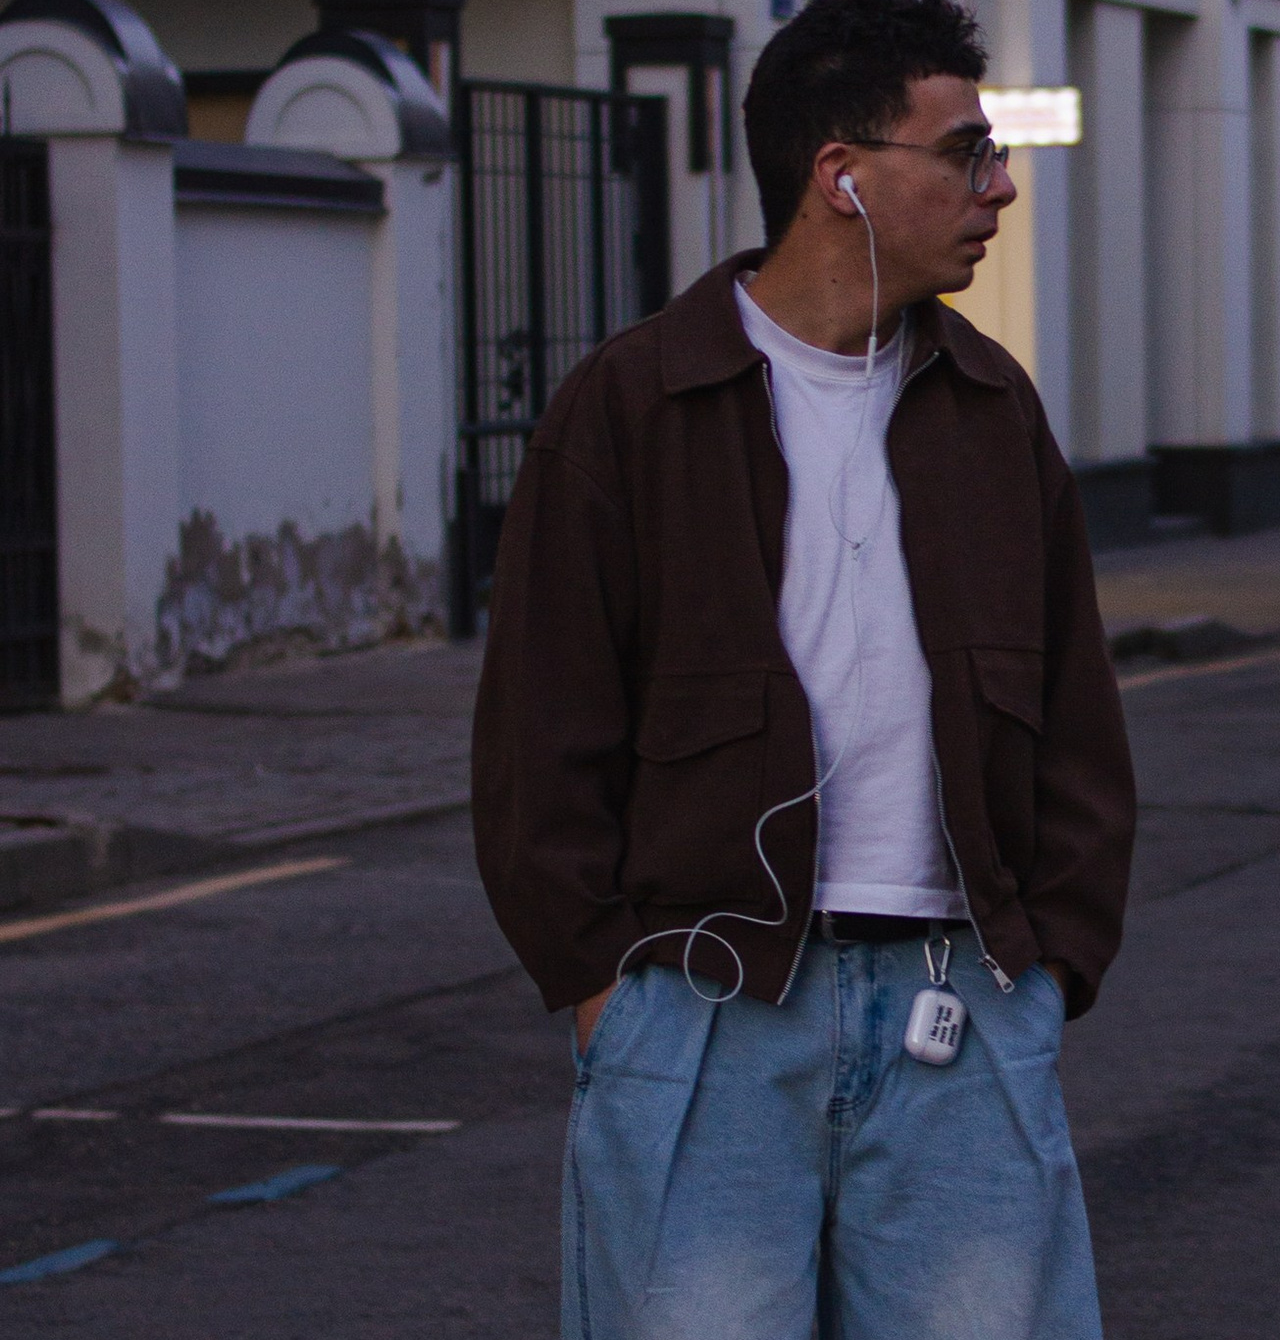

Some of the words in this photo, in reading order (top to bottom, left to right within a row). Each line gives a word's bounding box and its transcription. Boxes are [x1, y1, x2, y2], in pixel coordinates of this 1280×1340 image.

[943, 1006, 953, 1022] than
[939, 1025, 948, 1044] more
[948, 1023, 959, 1047] people
